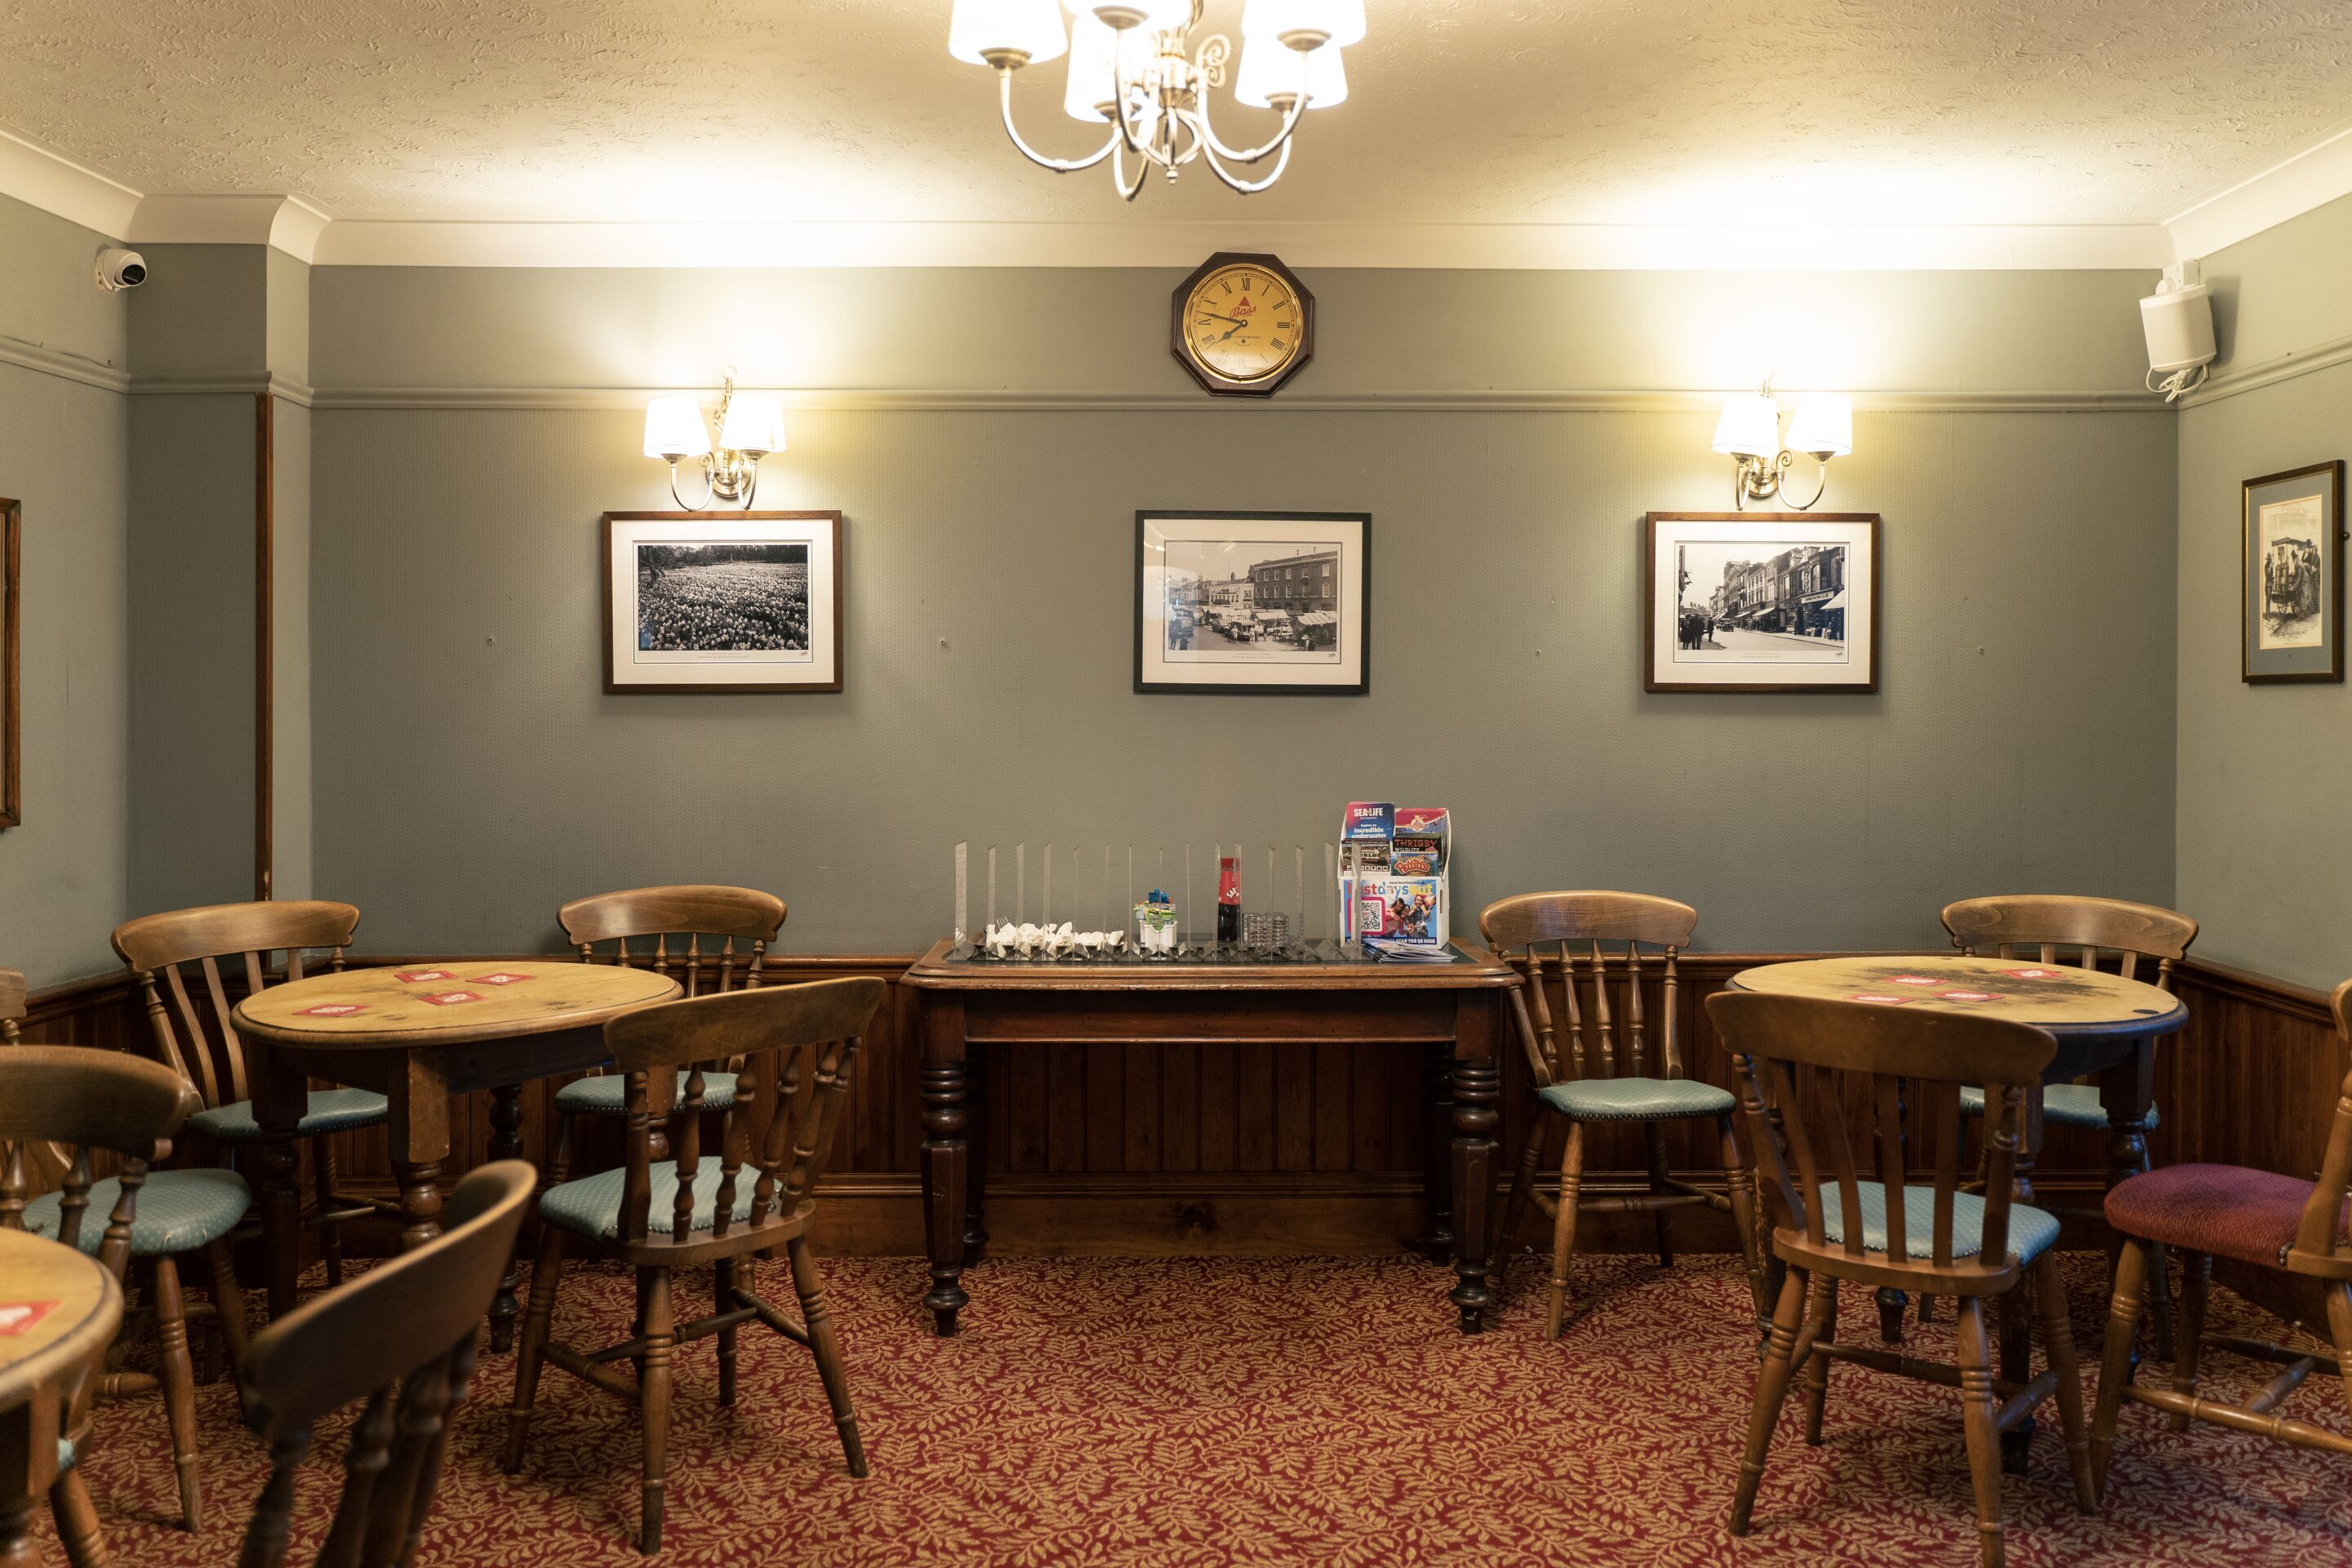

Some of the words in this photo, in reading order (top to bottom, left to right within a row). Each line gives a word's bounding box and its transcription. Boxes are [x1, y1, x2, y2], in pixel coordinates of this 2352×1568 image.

[1241, 278, 1251, 291] XII
[1229, 305, 1256, 318] Bass
[1394, 839, 1437, 847] THRIGBY
